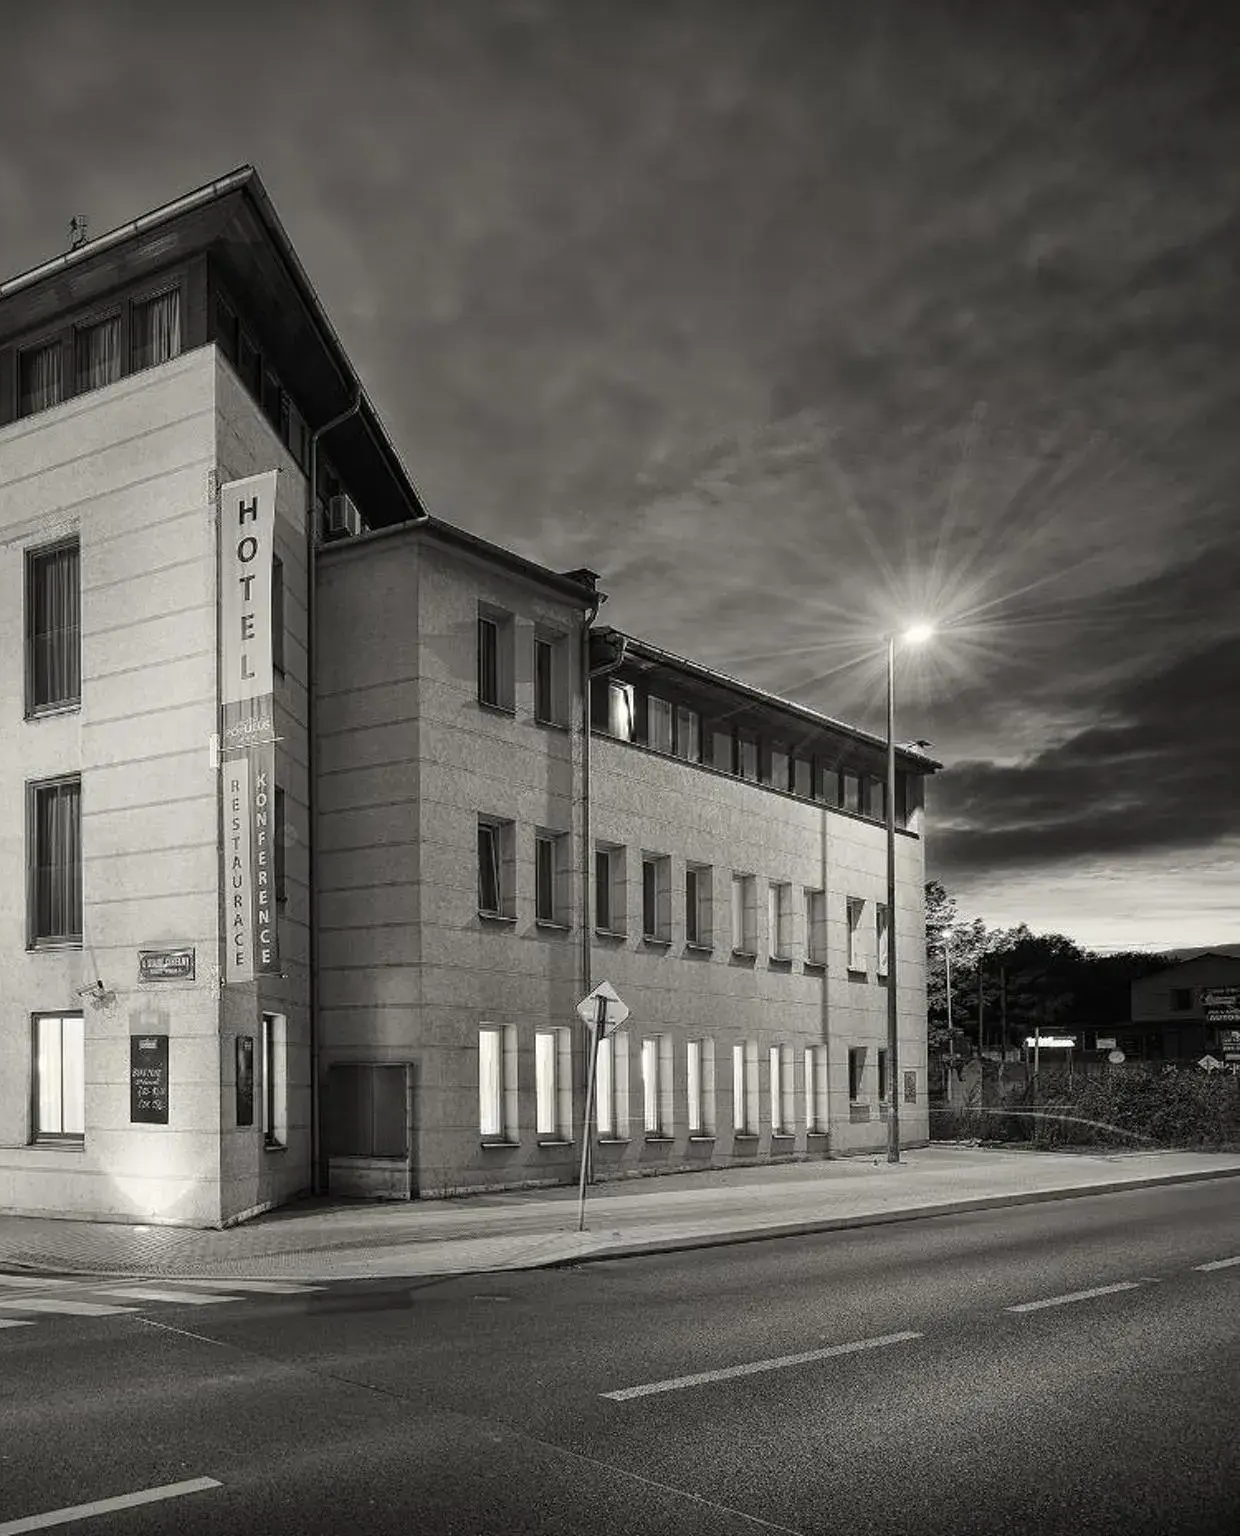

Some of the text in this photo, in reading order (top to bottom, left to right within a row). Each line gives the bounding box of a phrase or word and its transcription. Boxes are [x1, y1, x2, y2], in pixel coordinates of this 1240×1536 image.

[237, 496, 258, 681] HOTEL
[231, 780, 245, 966] RESTAURACE
[256, 774, 271, 963] KONFERENCE
